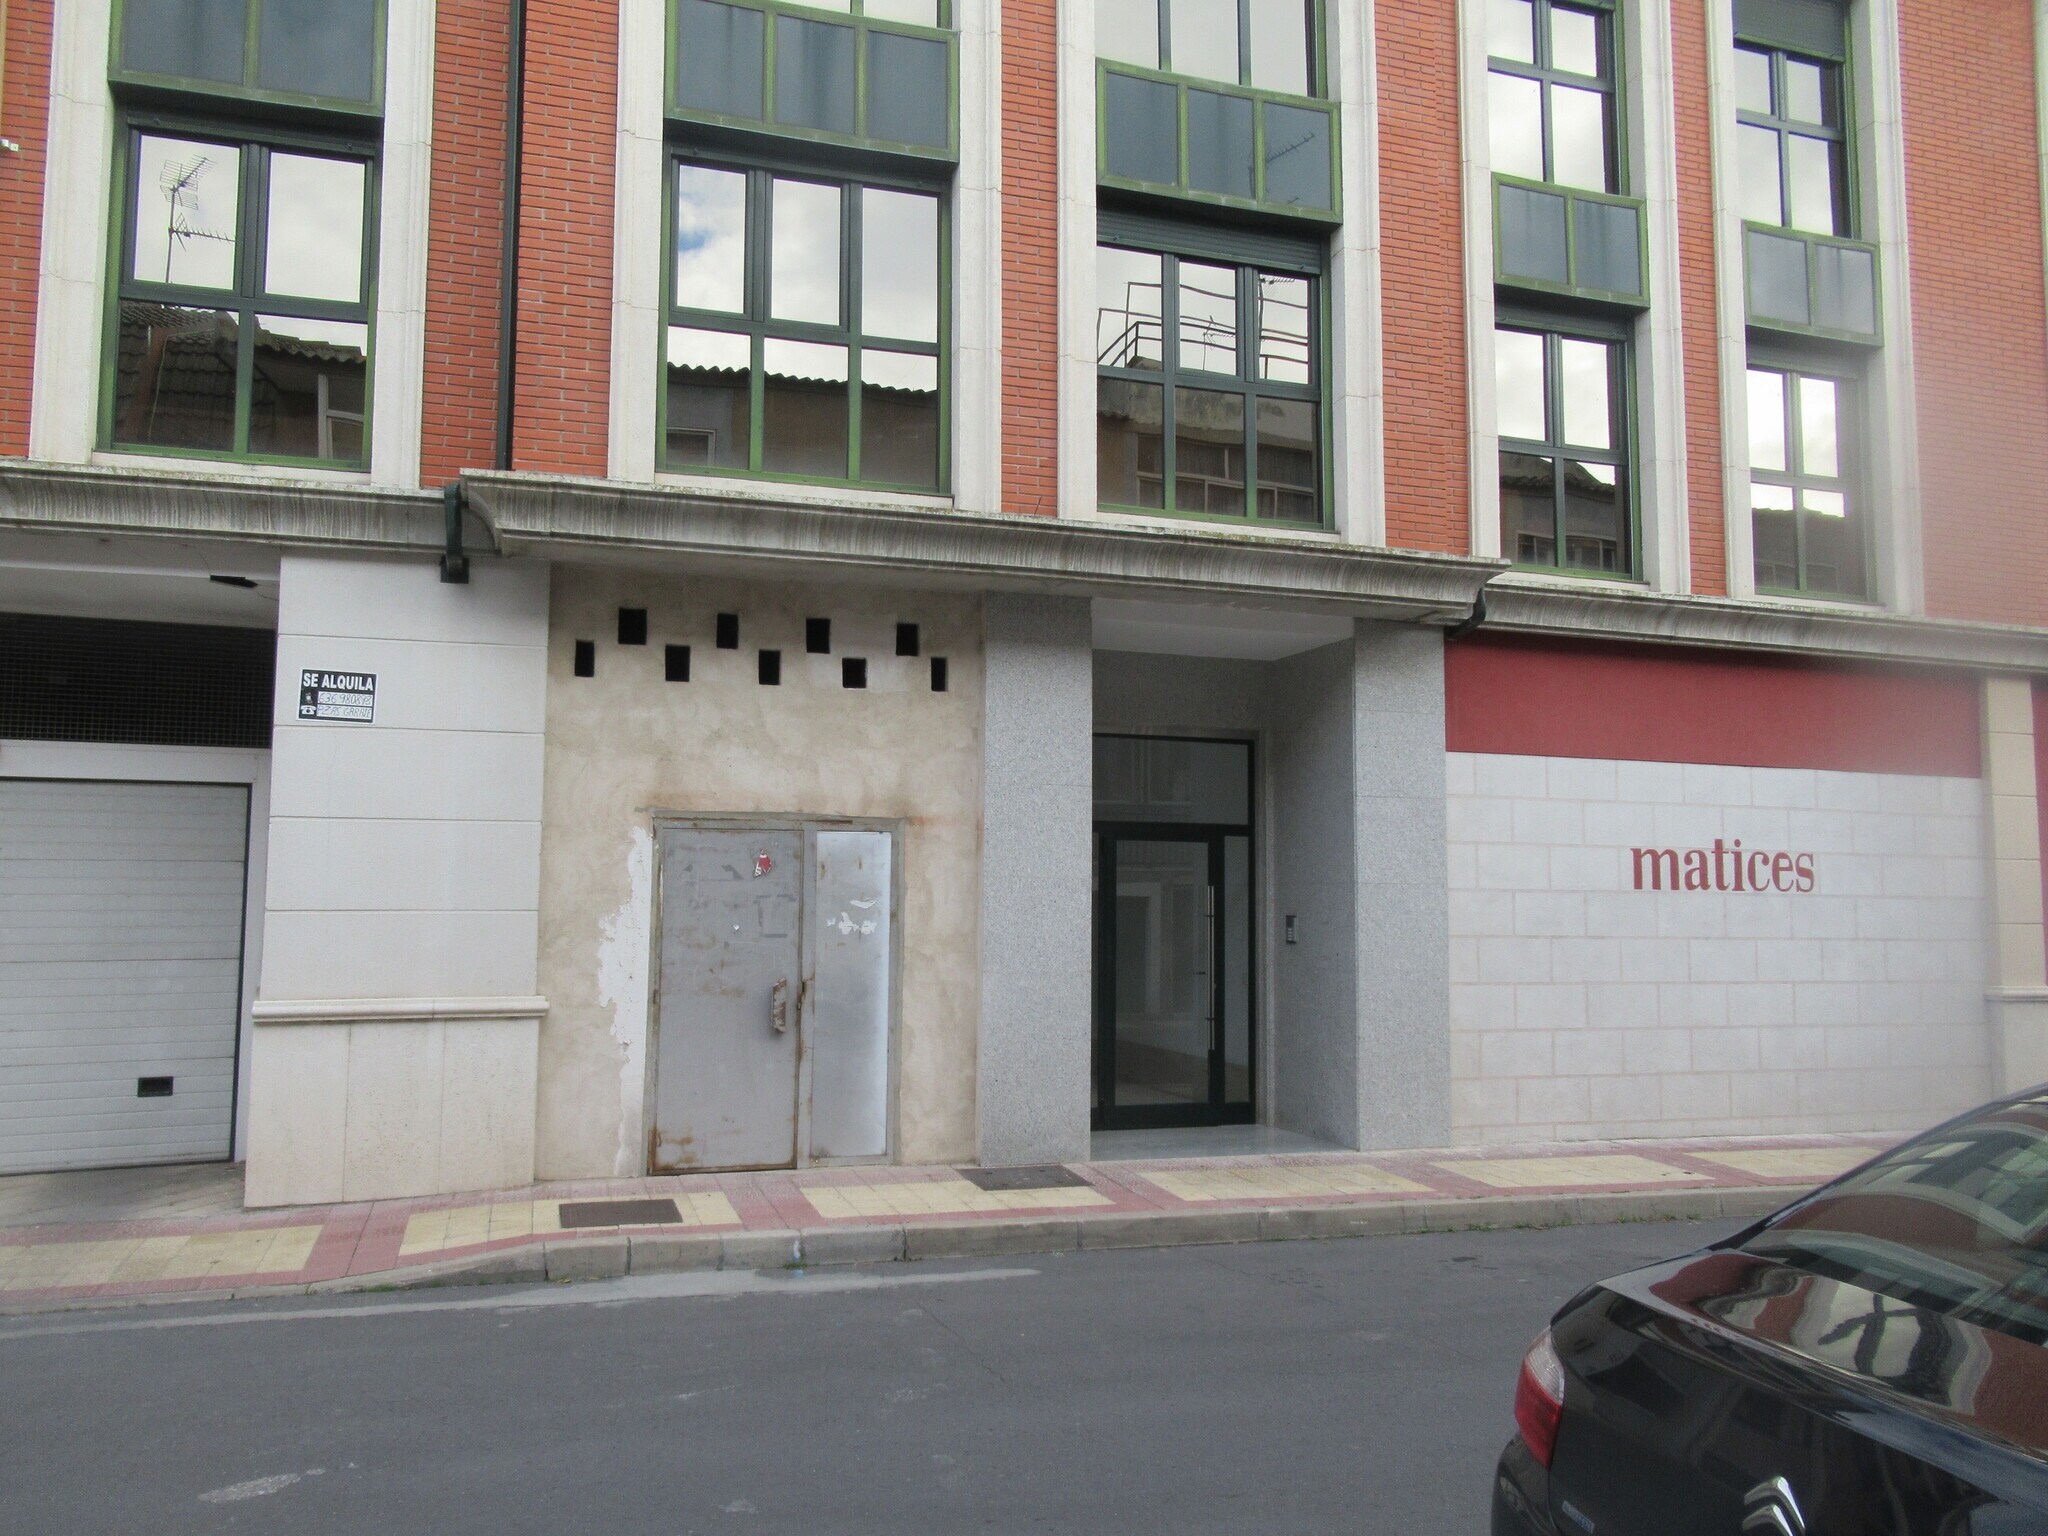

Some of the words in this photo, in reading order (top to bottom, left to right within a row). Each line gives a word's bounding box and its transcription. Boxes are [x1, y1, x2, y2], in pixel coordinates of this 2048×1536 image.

[303, 673, 318, 687] SE
[321, 674, 373, 691] ALQUILA
[1630, 839, 1814, 892] matices
